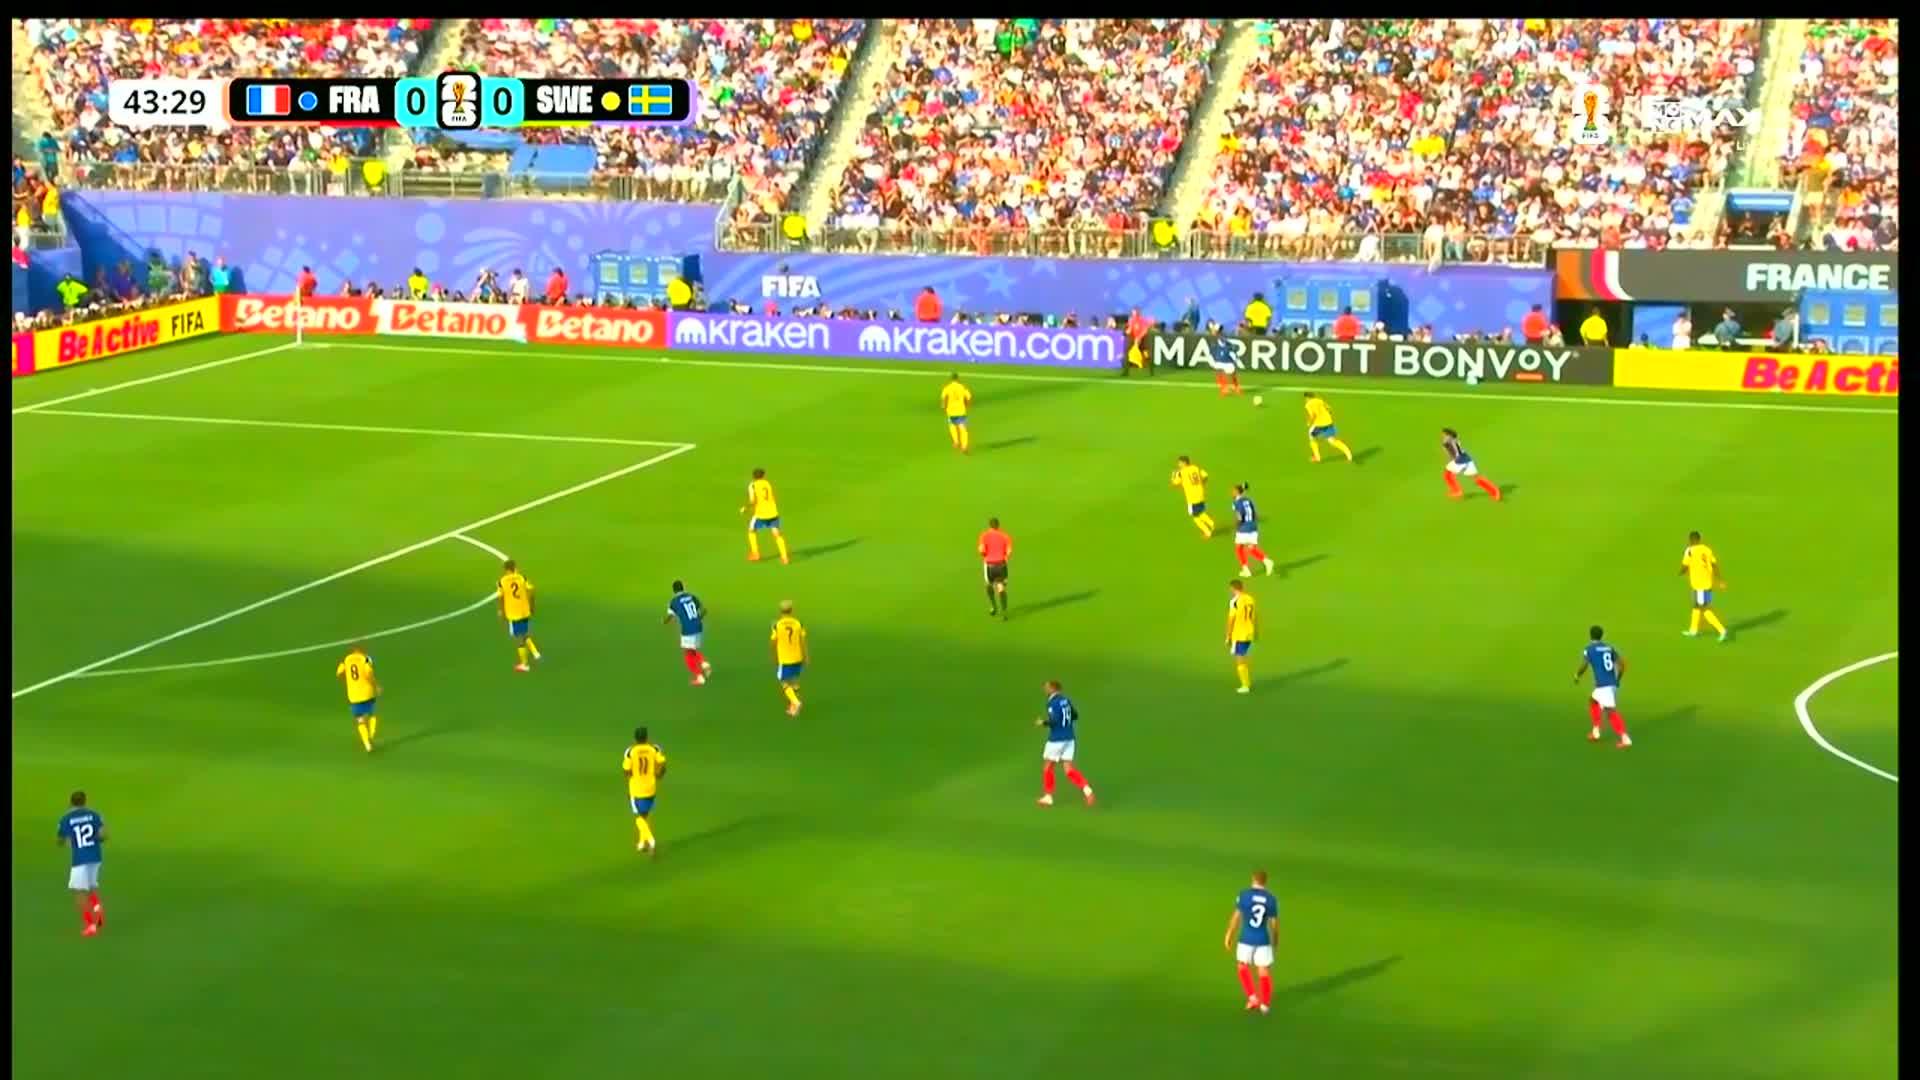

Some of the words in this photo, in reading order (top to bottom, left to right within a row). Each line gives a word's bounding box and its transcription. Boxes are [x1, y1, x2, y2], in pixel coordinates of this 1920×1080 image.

[761, 275, 821, 298] FIFA
[1746, 262, 1891, 291] FRANCE
[234, 298, 361, 330] Betano
[391, 303, 507, 336] Betano
[536, 309, 654, 343] Betano
[58, 329, 88, 364] Be
[92, 315, 160, 356] Active
[171, 311, 205, 337] FIFA
[708, 318, 830, 350] kraken
[893, 326, 1115, 362] kraken.com
[1741, 356, 1800, 391] Be
[511, 581, 520, 599] 2
[683, 601, 698, 620] 10
[785, 626, 792, 644] 7
[350, 663, 360, 681] 8
[1603, 652, 1613, 671] 8
[639, 756, 648, 776] 11
[73, 823, 95, 849] 12
[1249, 904, 1266, 928] 3
